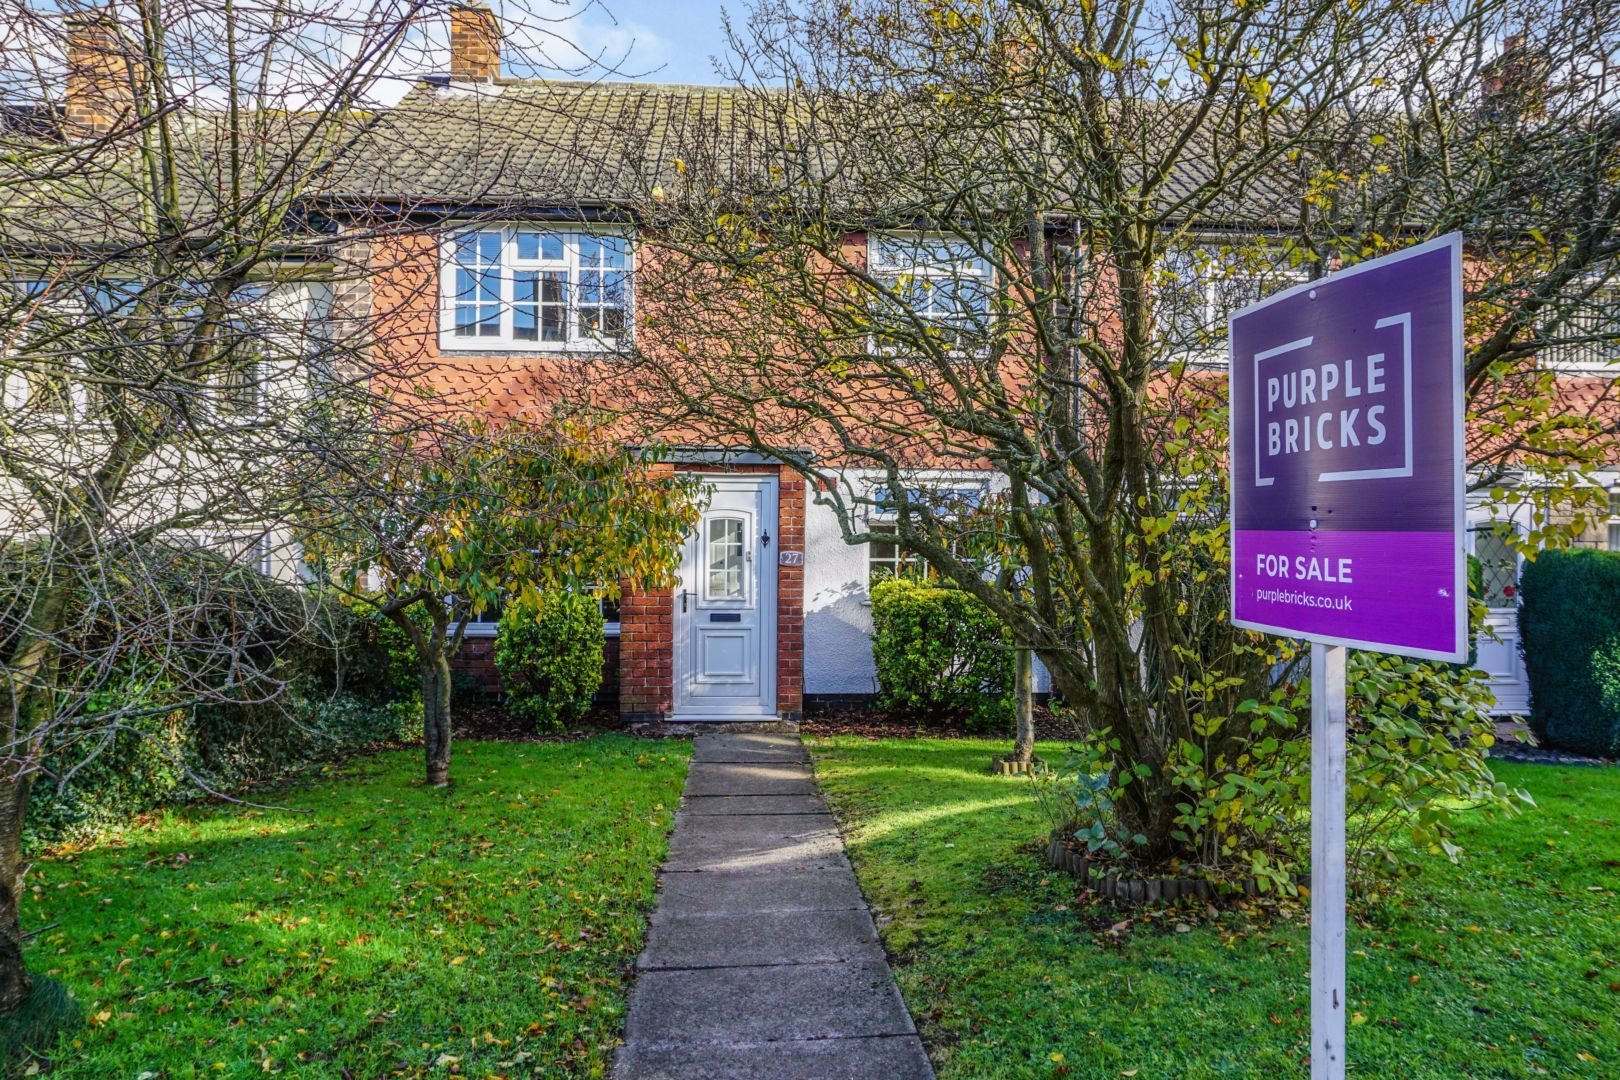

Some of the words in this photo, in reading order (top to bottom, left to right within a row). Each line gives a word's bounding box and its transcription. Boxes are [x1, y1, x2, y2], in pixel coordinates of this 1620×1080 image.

[1268, 353, 1386, 412] PURPLE
[1268, 405, 1387, 456] BRICKS
[785, 553, 799, 564] 27
[1256, 554, 1290, 578] FOR
[1295, 556, 1353, 584] SALE
[1256, 588, 1353, 611] purplebricks.co.uk
